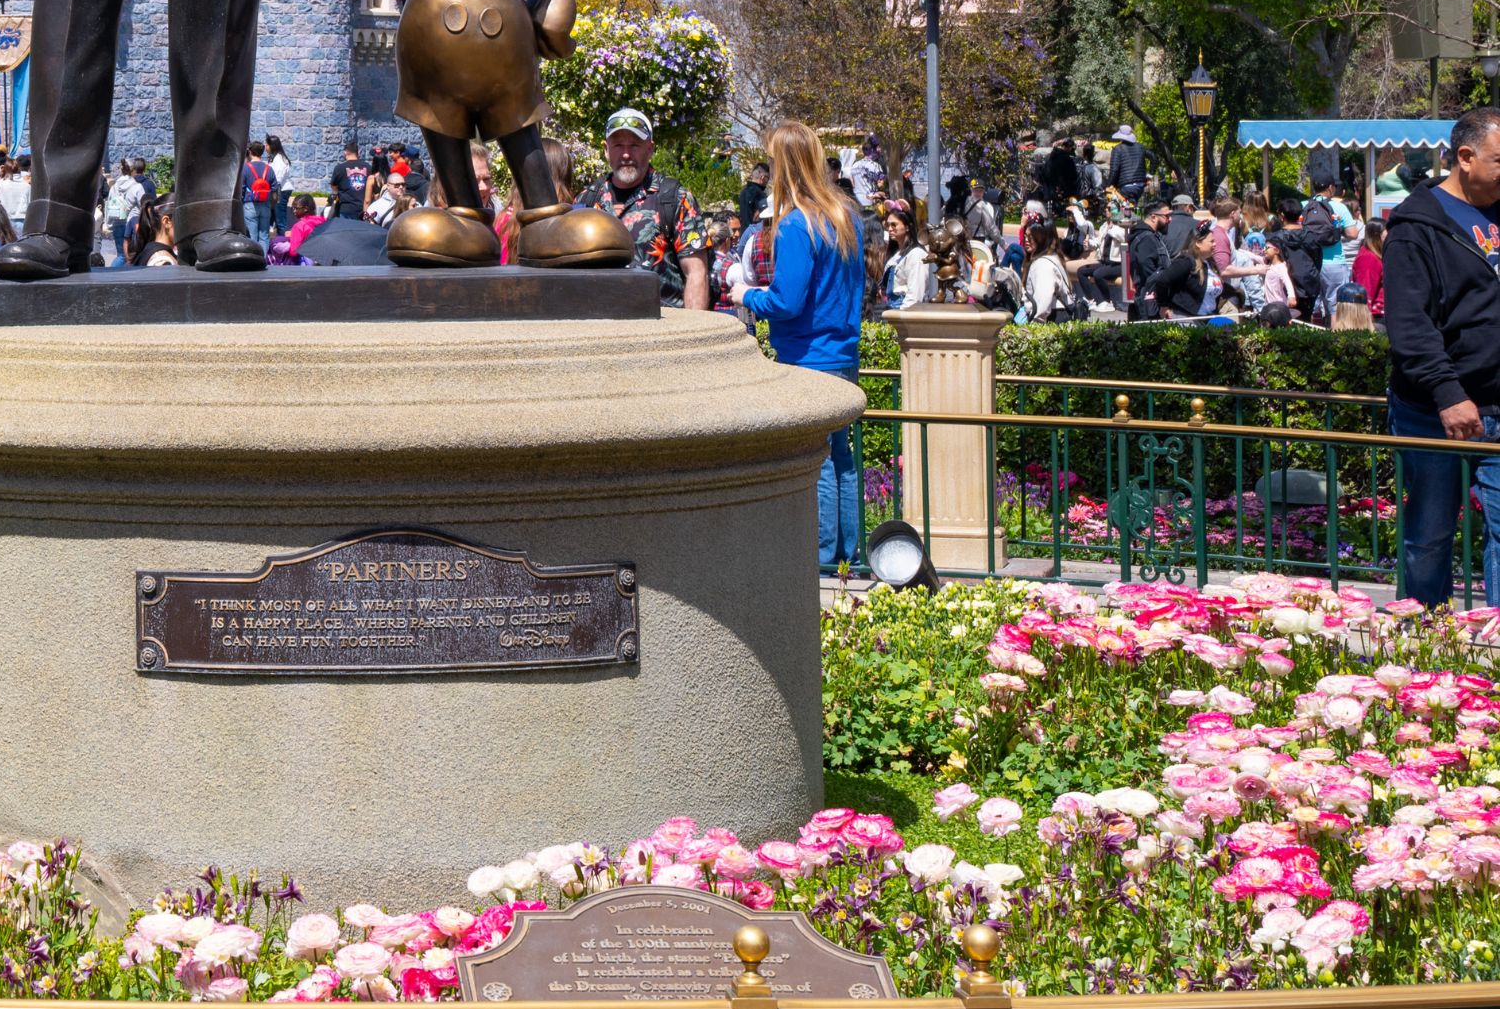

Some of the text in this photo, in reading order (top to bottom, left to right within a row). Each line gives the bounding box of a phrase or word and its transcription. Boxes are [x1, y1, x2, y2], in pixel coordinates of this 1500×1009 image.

[316, 560, 480, 583] “PARTNERS”
[209, 599, 257, 612] THINK
[259, 599, 302, 612] MOST
[305, 600, 326, 612] OF
[328, 600, 358, 612] ALL
[361, 599, 404, 611] WHAT
[407, 599, 415, 610] I
[417, 598, 459, 610] WANT
[461, 595, 551, 610] DISNEYLAND
[553, 594, 572, 607] TO
[574, 592, 592, 606] BE
[211, 617, 225, 630] IS
[228, 617, 240, 630] A
[243, 617, 293, 630] HAPPY
[410, 615, 472, 629] PARENTS
[476, 614, 506, 627] AND
[509, 611, 578, 626] CHILDREN
[222, 635, 253, 648] CAN
[256, 635, 299, 648] HAVE
[605, 899, 712, 914] December 5, 2001
[615, 924, 715, 936] In celebration
[580, 938, 597, 949] of
[600, 938, 624, 949] the
[627, 938, 671, 949] 100th
[552, 952, 569, 963] of
[570, 952, 595, 963] his
[595, 952, 637, 964] birth,
[639, 952, 665, 963] the
[667, 953, 712, 964] statue
[577, 967, 590, 977] is
[593, 966, 674, 978] rededicated
[677, 969, 693, 978] as
[696, 969, 706, 978] a
[760, 968, 776, 978] to
[547, 981, 573, 992] the
[574, 980, 636, 993] Dreams,
[640, 980, 712, 994] Creativity
[715, 982, 733, 992] an
[796, 981, 813, 993] of
